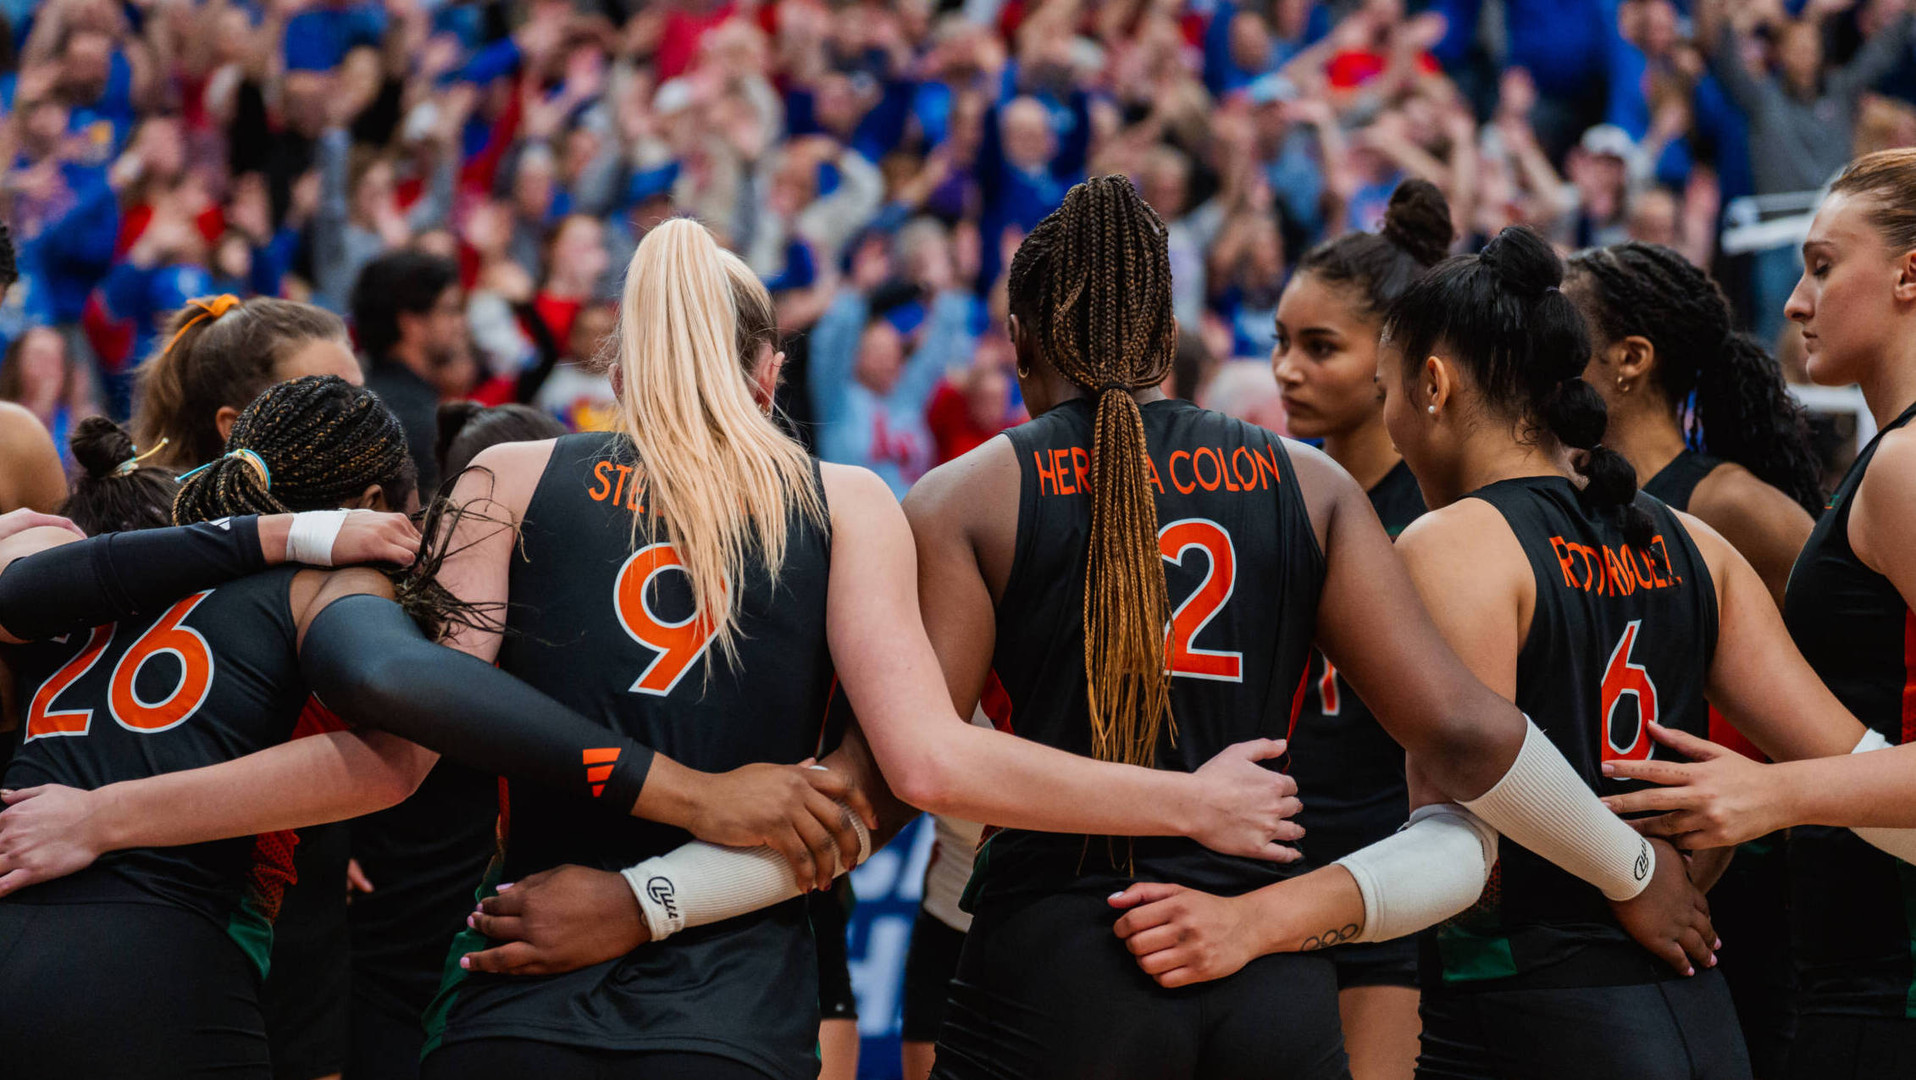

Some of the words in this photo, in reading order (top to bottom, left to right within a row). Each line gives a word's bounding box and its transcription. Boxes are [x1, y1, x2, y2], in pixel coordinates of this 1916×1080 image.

[1034, 446, 1165, 497] HERA
[24, 588, 216, 745] 26
[613, 541, 733, 697] 9
[1600, 619, 1659, 780] 6
